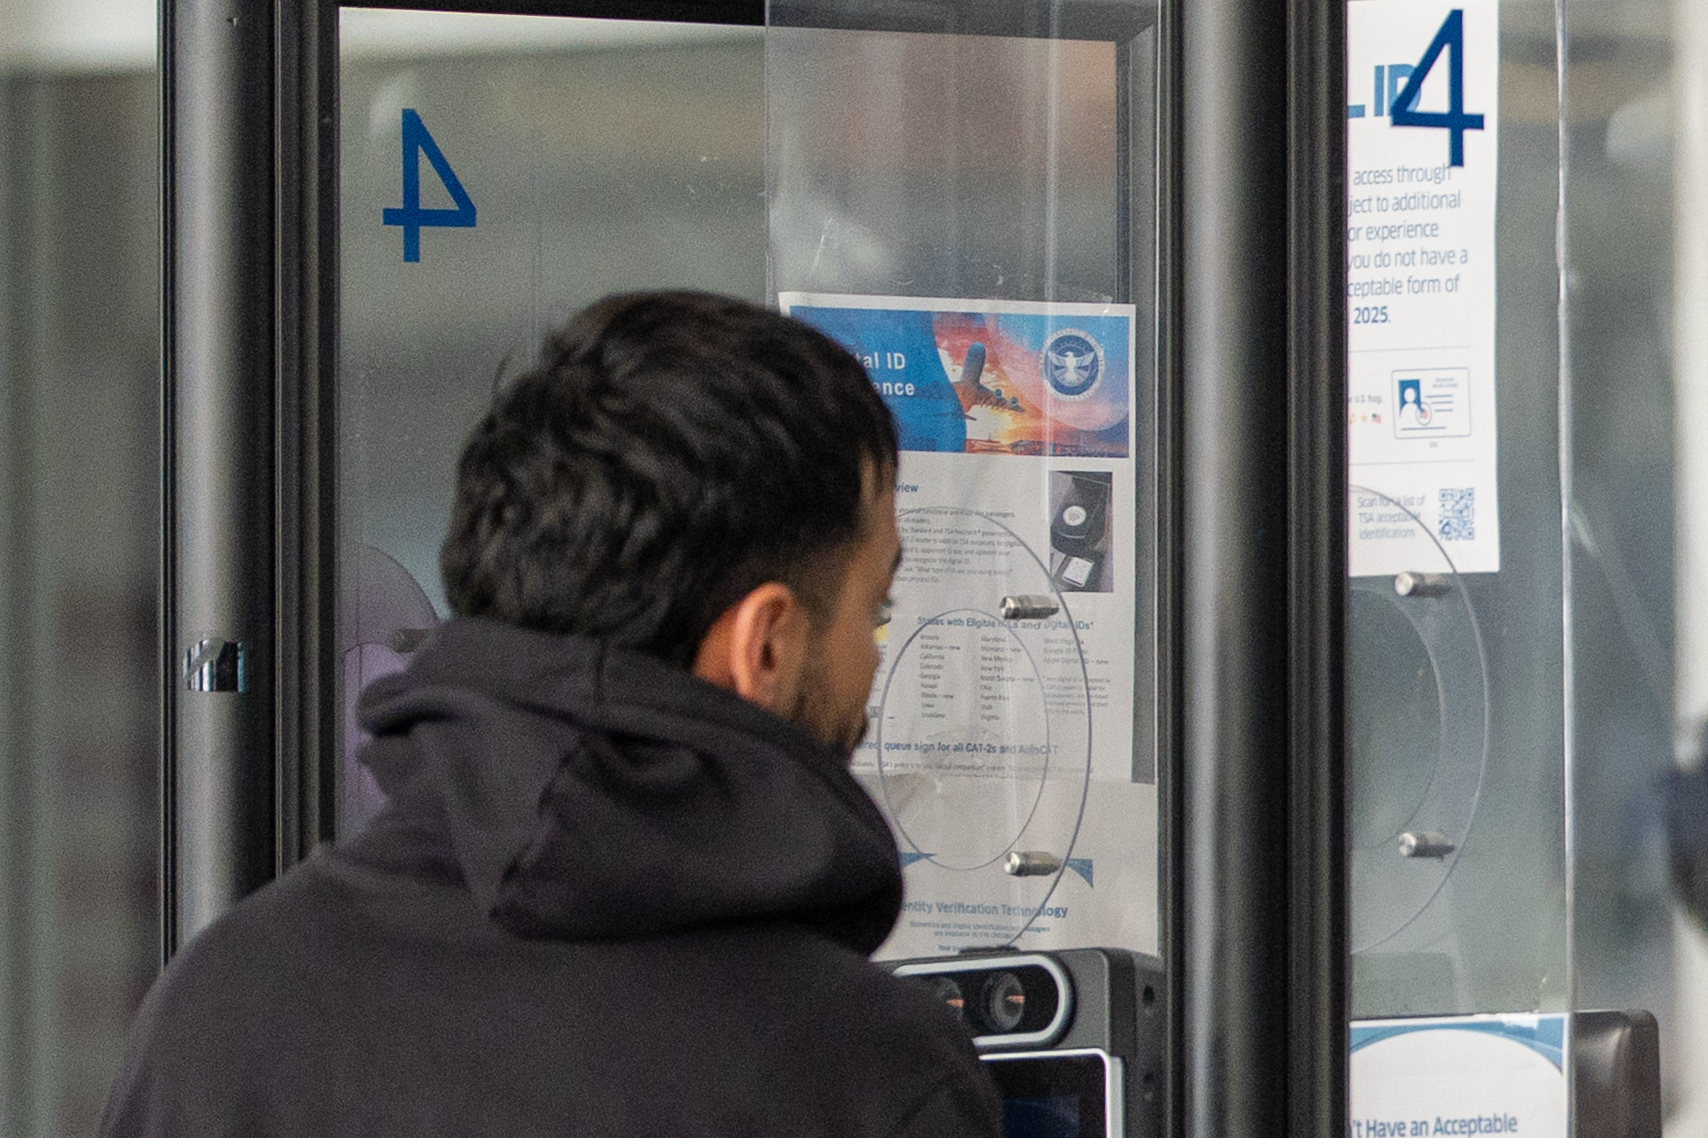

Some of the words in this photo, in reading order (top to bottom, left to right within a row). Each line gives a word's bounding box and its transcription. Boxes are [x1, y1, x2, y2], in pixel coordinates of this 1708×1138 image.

[1391, 8, 1484, 167] 4
[1353, 168, 1393, 186] access
[1396, 162, 1451, 185] through
[1377, 195, 1389, 213] to
[1391, 189, 1461, 212] additional
[1366, 220, 1439, 243] experience
[1374, 250, 1391, 269] do
[1395, 249, 1416, 267] not
[1420, 246, 1456, 265] have
[1459, 248, 1468, 264] a
[1407, 274, 1441, 295] form
[1445, 273, 1460, 293] of
[1353, 305, 1391, 325] 2025.
[886, 352, 906, 370] ID
[1358, 511, 1374, 524] TSA
[914, 742, 935, 754] sign
[937, 742, 951, 752] for
[953, 742, 964, 752] all
[936, 902, 999, 915] Verification
[1366, 1118, 1406, 1138] Have
[1410, 1121, 1429, 1137] an
[1433, 1113, 1518, 1138] Acceptable
